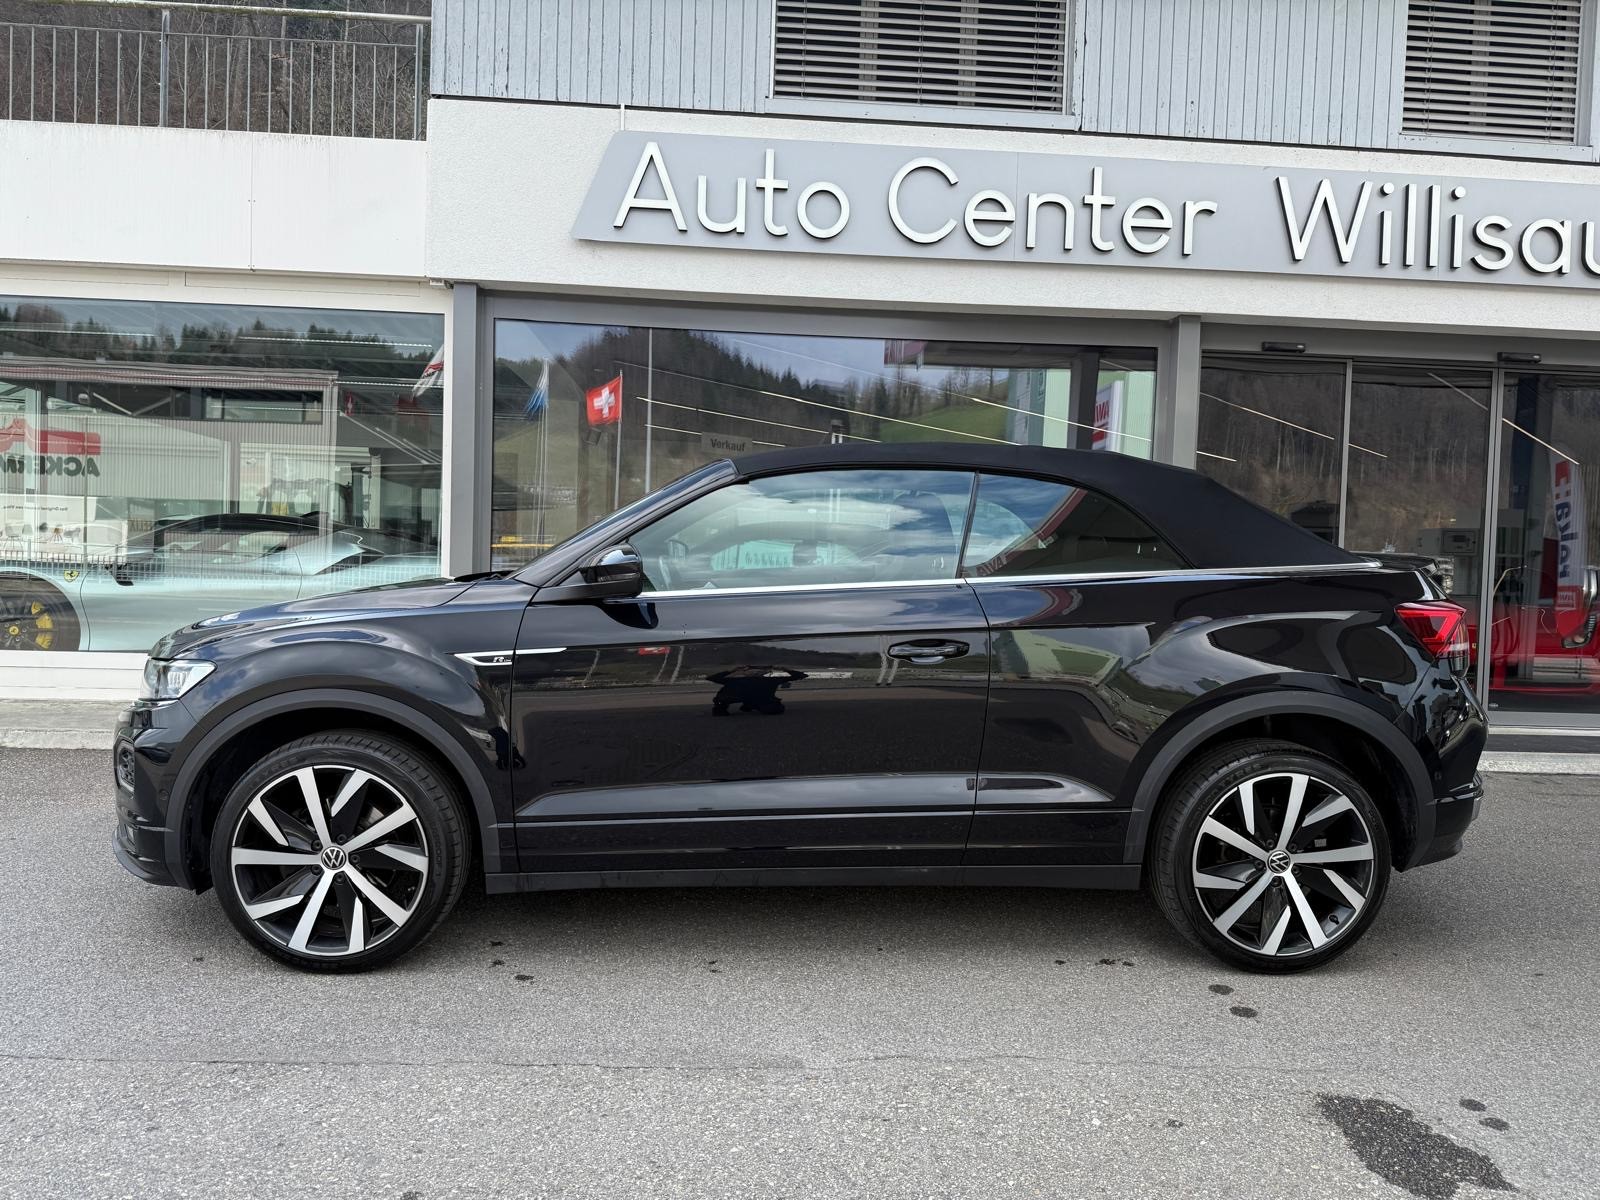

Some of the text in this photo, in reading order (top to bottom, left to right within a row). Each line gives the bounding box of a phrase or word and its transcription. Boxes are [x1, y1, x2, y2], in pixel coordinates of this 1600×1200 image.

[613, 141, 849, 239] Auto
[888, 157, 1217, 256] Center
[710, 438, 746, 451] Verkauf
